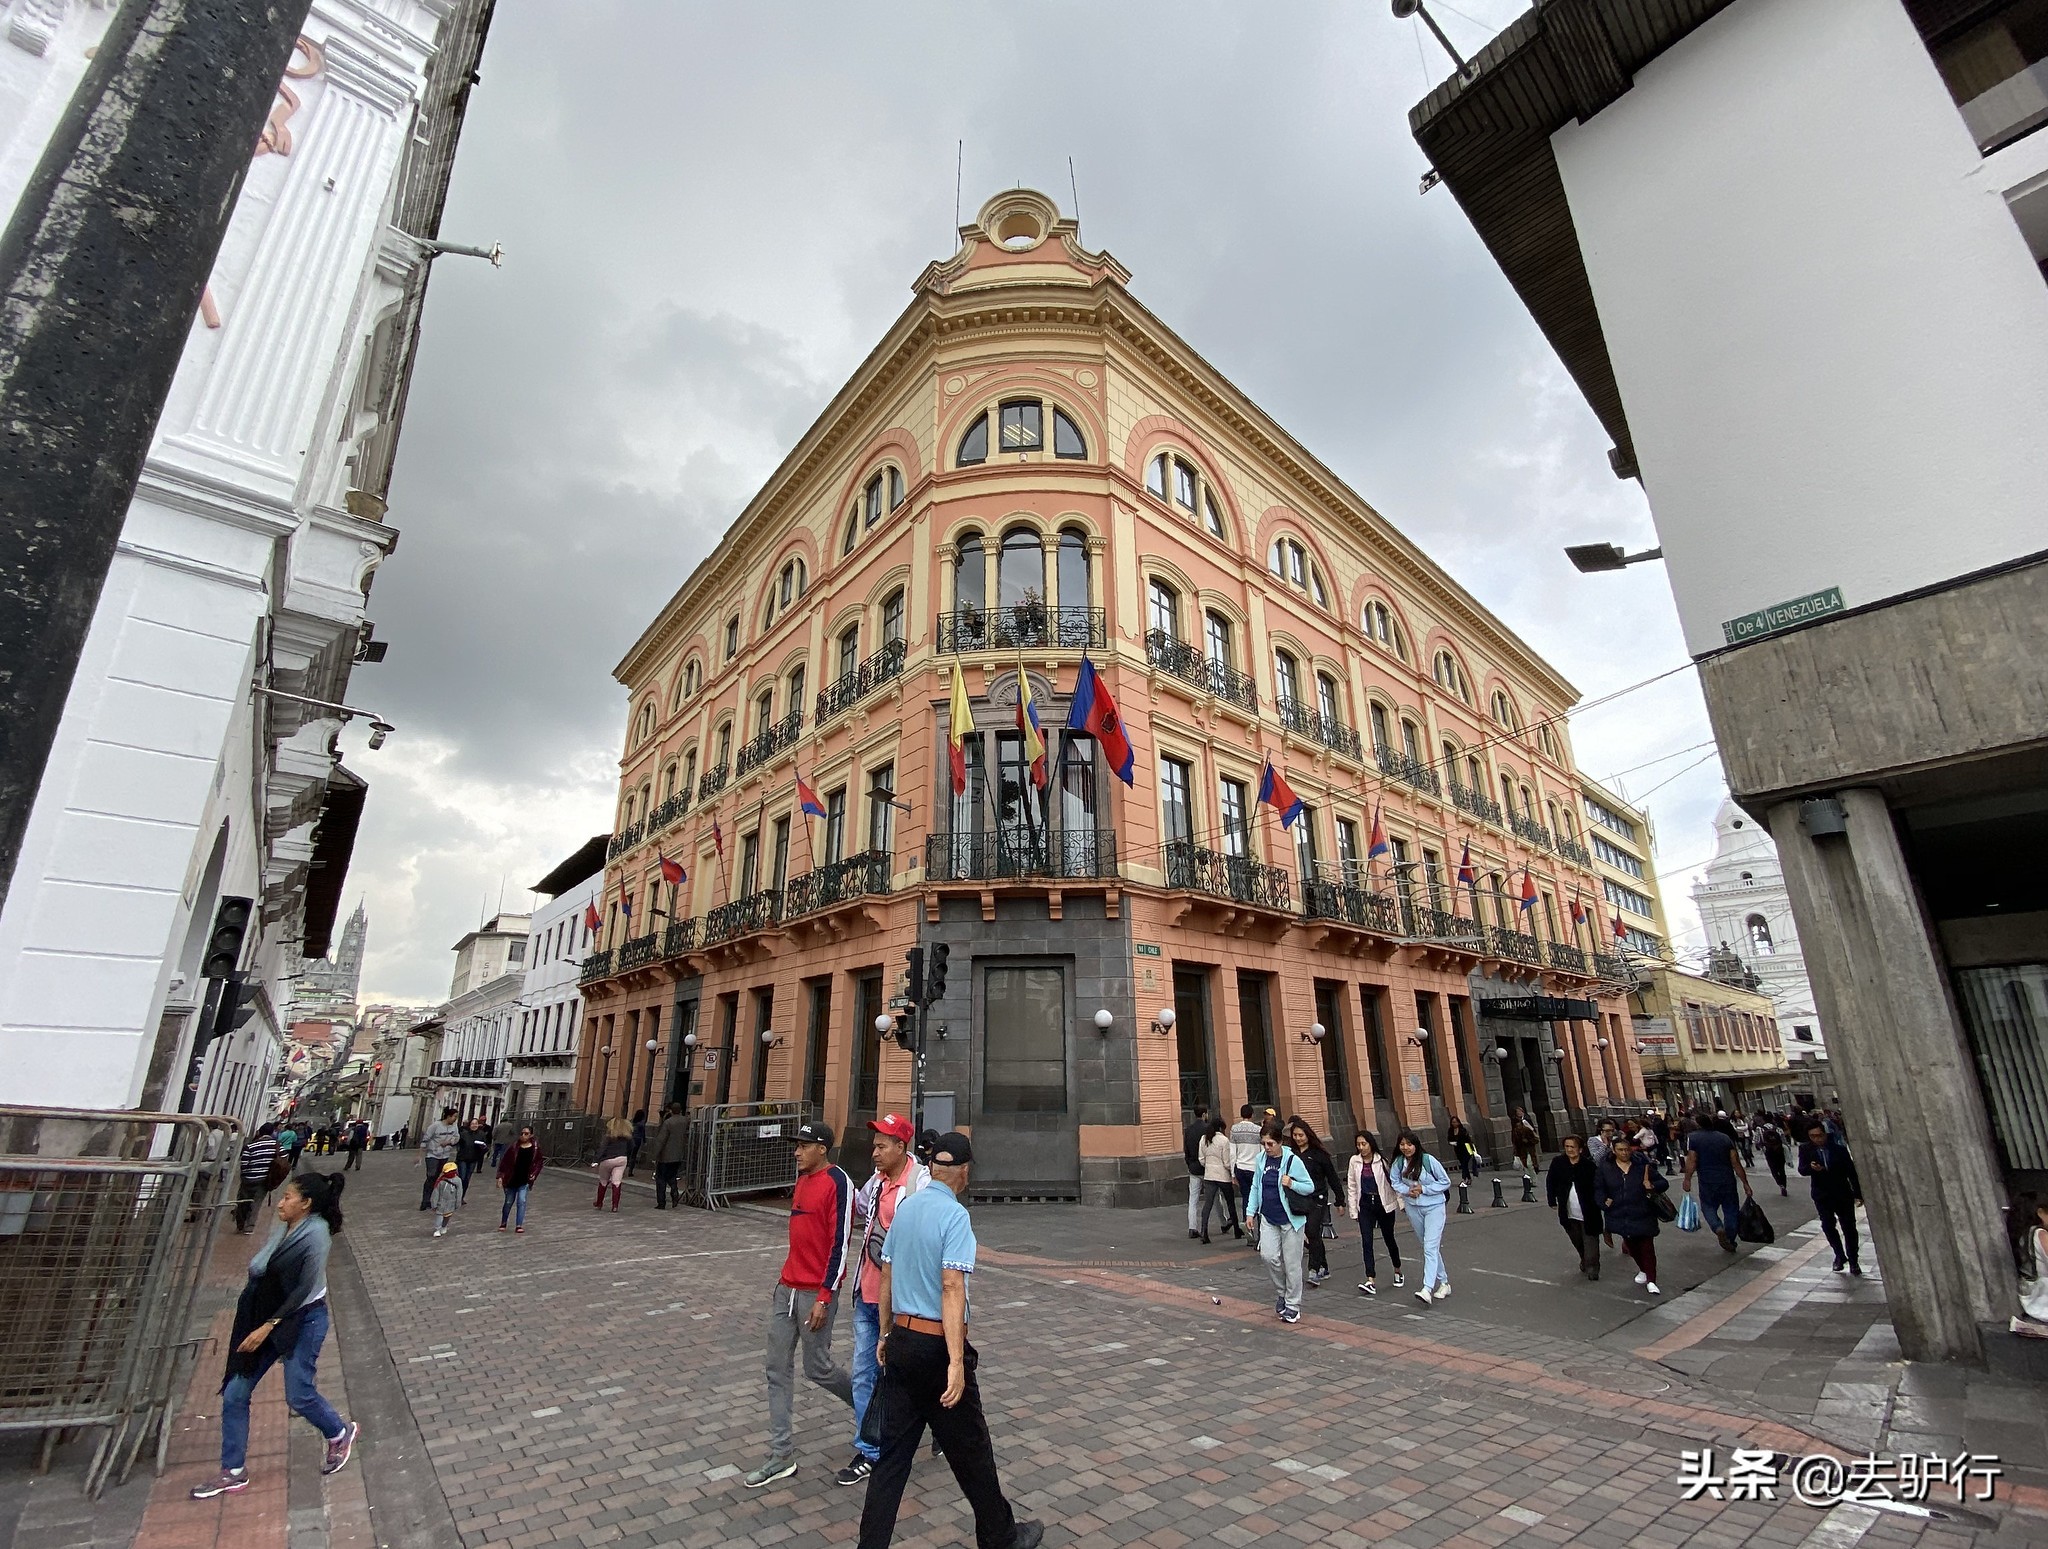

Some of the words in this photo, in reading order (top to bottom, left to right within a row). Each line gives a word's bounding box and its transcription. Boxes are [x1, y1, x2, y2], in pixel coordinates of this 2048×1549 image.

[1736, 621, 1754, 635] Oe
[1755, 616, 1764, 629] 4
[1767, 593, 1841, 626] VENEZUELA
